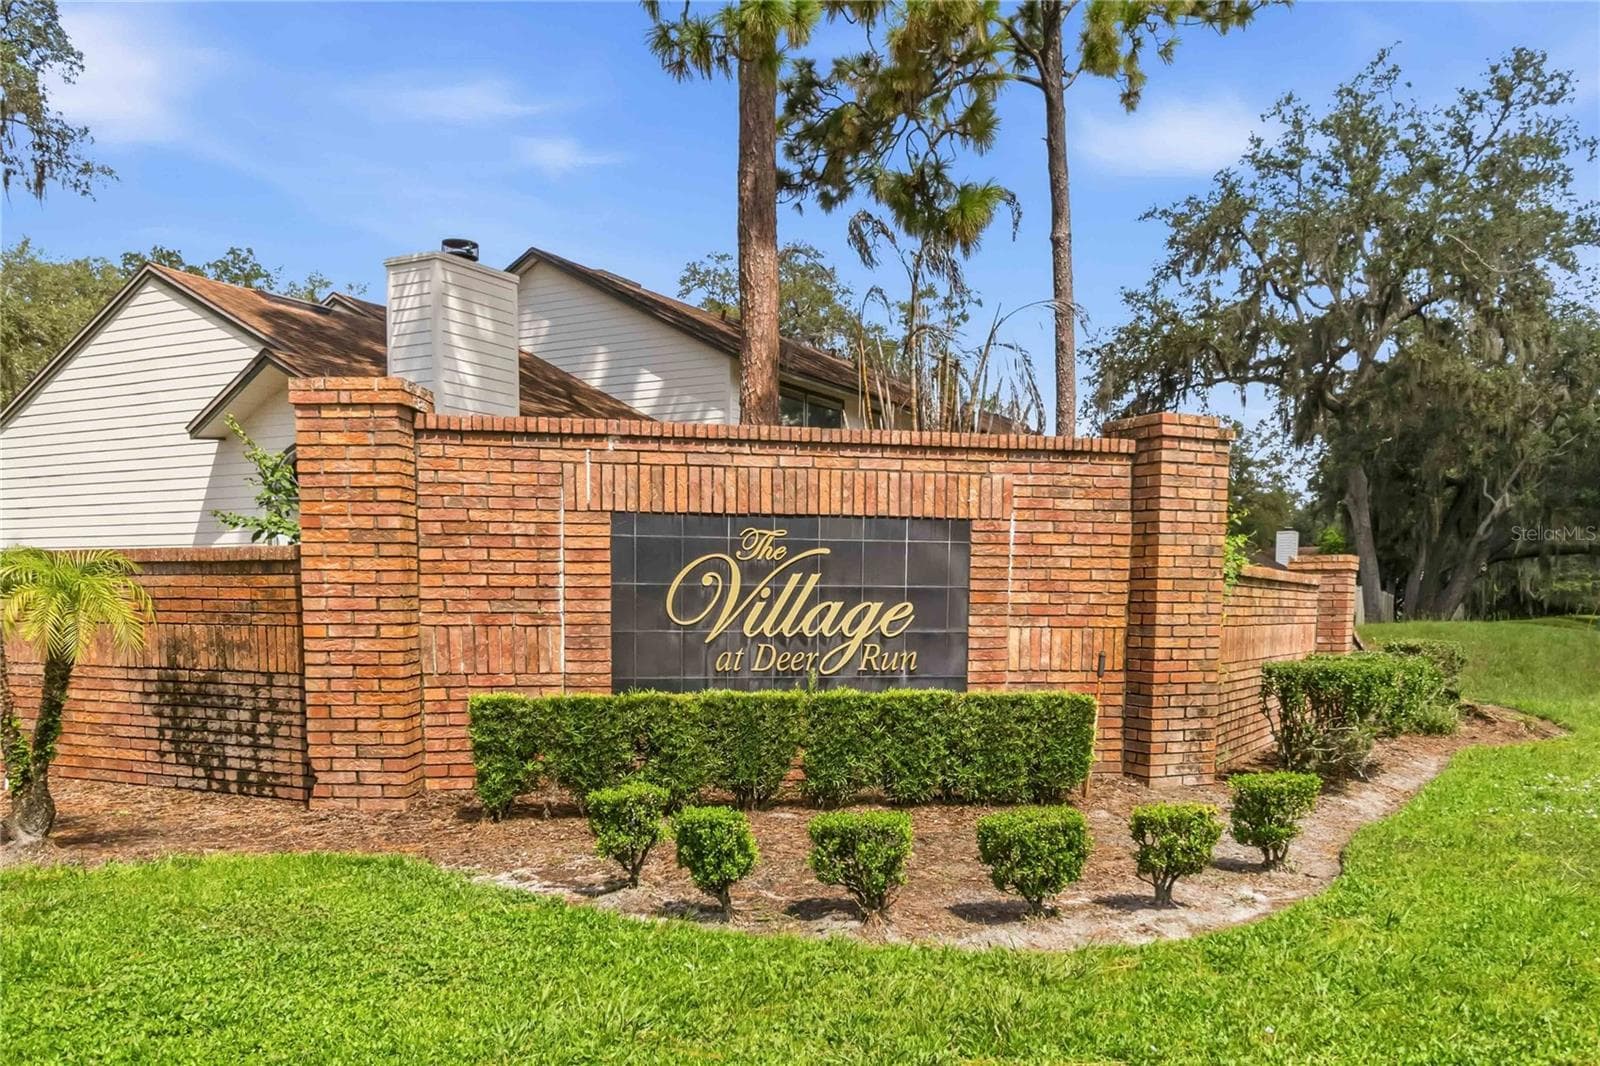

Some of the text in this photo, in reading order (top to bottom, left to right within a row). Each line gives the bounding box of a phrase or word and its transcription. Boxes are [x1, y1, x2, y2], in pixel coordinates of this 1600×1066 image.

[736, 527, 788, 561] The
[665, 547, 915, 675] Village
[715, 643, 918, 673] at Deer Run
